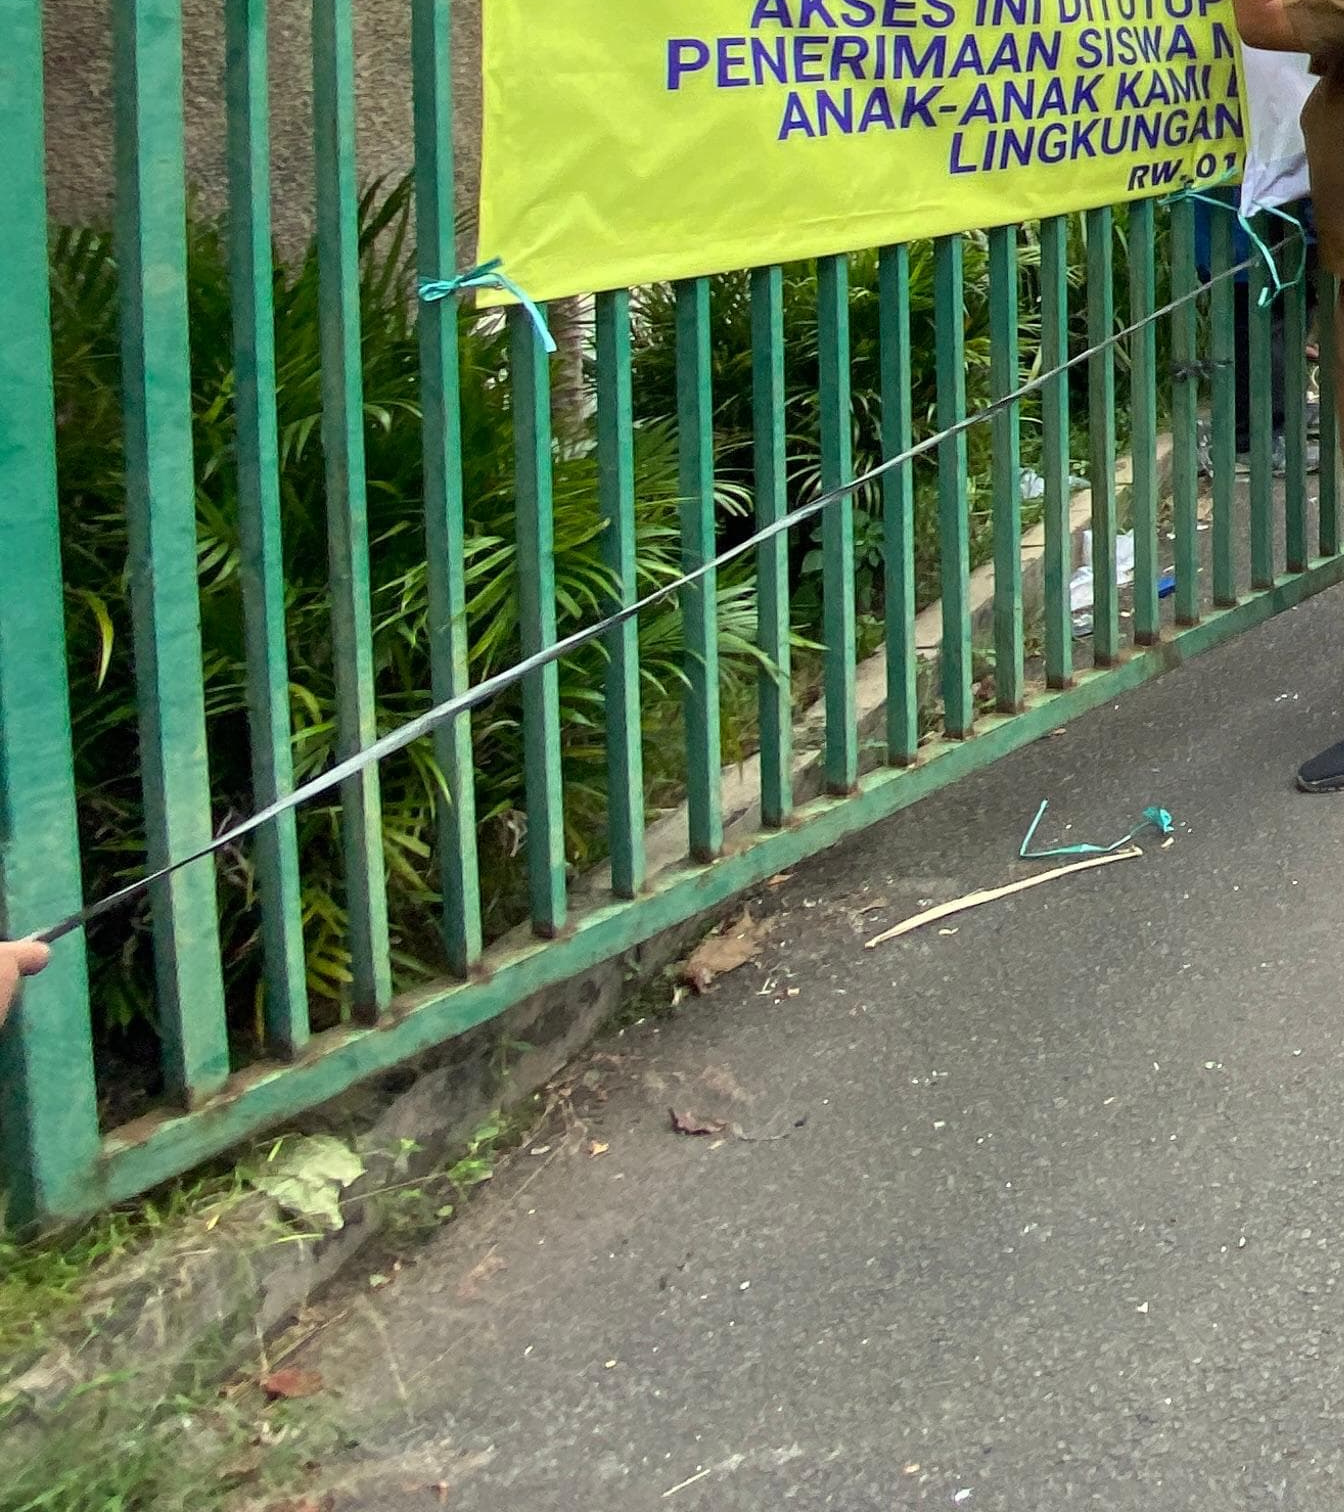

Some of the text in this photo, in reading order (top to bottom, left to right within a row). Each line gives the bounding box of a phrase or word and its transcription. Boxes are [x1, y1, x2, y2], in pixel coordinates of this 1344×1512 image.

[666, 31, 1061, 90] PENERIMAAN
[1076, 24, 1196, 69] SISWA
[777, 75, 1102, 140] ANAK-ANAK
[1115, 65, 1211, 109] KAMI
[949, 102, 1243, 175] LINGKUNGAN
